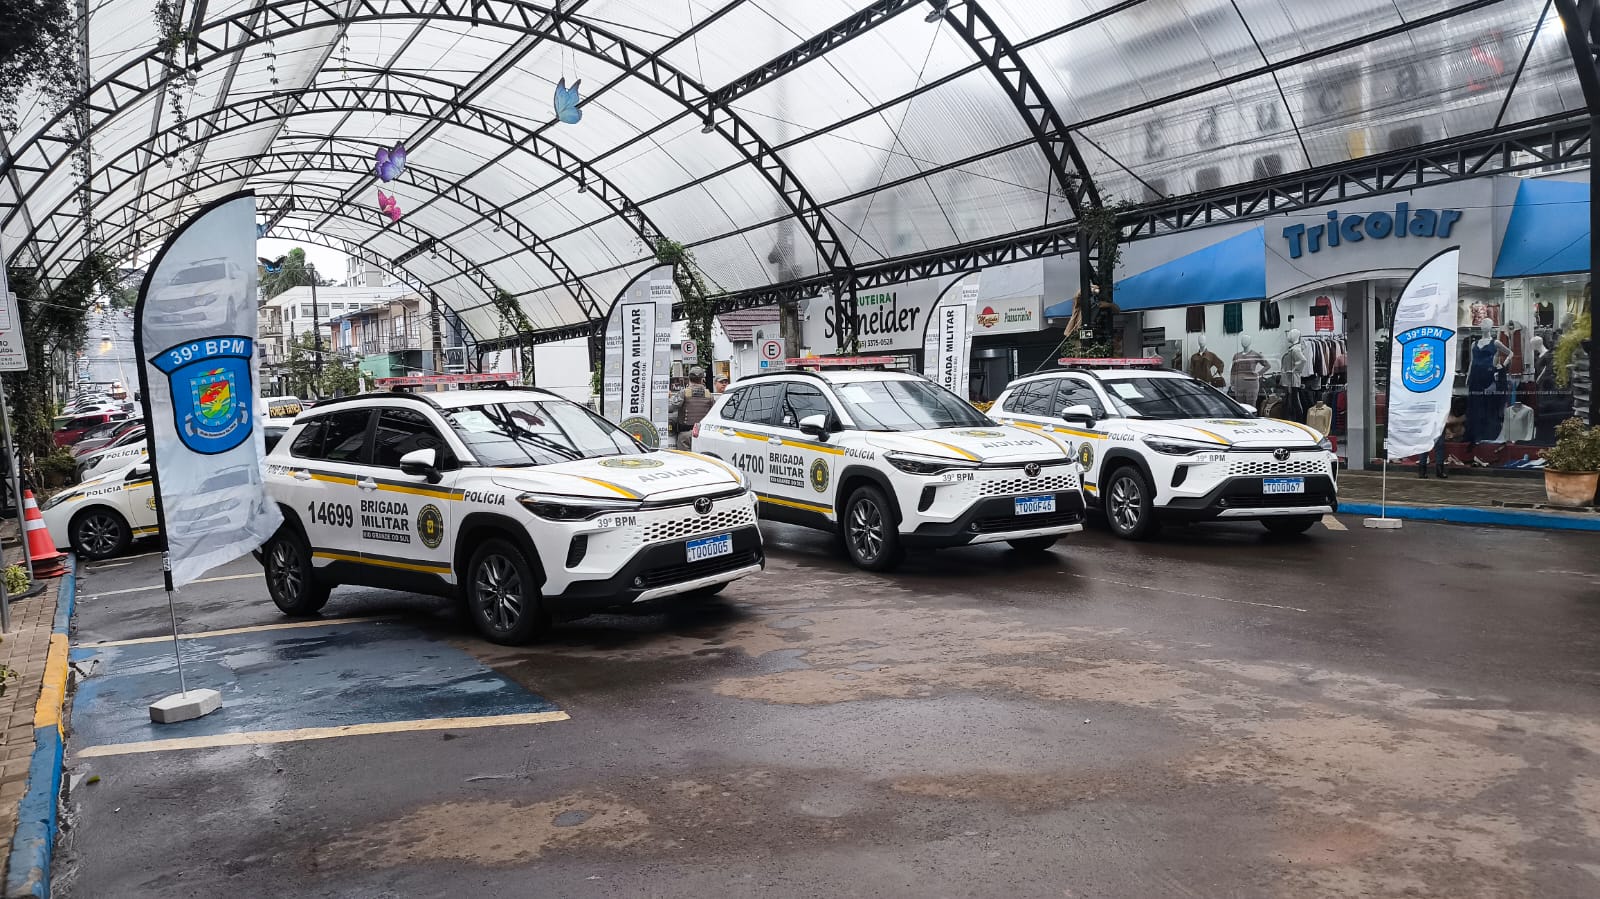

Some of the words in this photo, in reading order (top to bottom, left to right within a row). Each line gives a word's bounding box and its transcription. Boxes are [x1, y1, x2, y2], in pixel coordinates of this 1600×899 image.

[1283, 201, 1463, 259] Tricolar
[849, 292, 892, 307] UTEIRA
[824, 291, 921, 339] Sneider
[631, 308, 641, 357] MILITAR
[945, 309, 955, 353] MILITAR
[1421, 327, 1443, 338] BPM
[205, 340, 245, 356] BPM
[686, 344, 692, 352] E
[768, 344, 776, 356] E
[630, 361, 641, 414] BRIGADA
[769, 452, 804, 467] BRIGADA
[844, 447, 875, 461] POLÍCIA
[1209, 454, 1226, 462] BPM
[731, 452, 764, 475] 14700
[769, 464, 804, 479] MILITAR
[956, 473, 974, 481] BPM
[464, 490, 506, 506] POLÍCIA
[307, 500, 354, 529] 14699
[360, 499, 409, 516] BRIGADA
[361, 514, 410, 532] MILITAR
[615, 516, 637, 527] BPM
